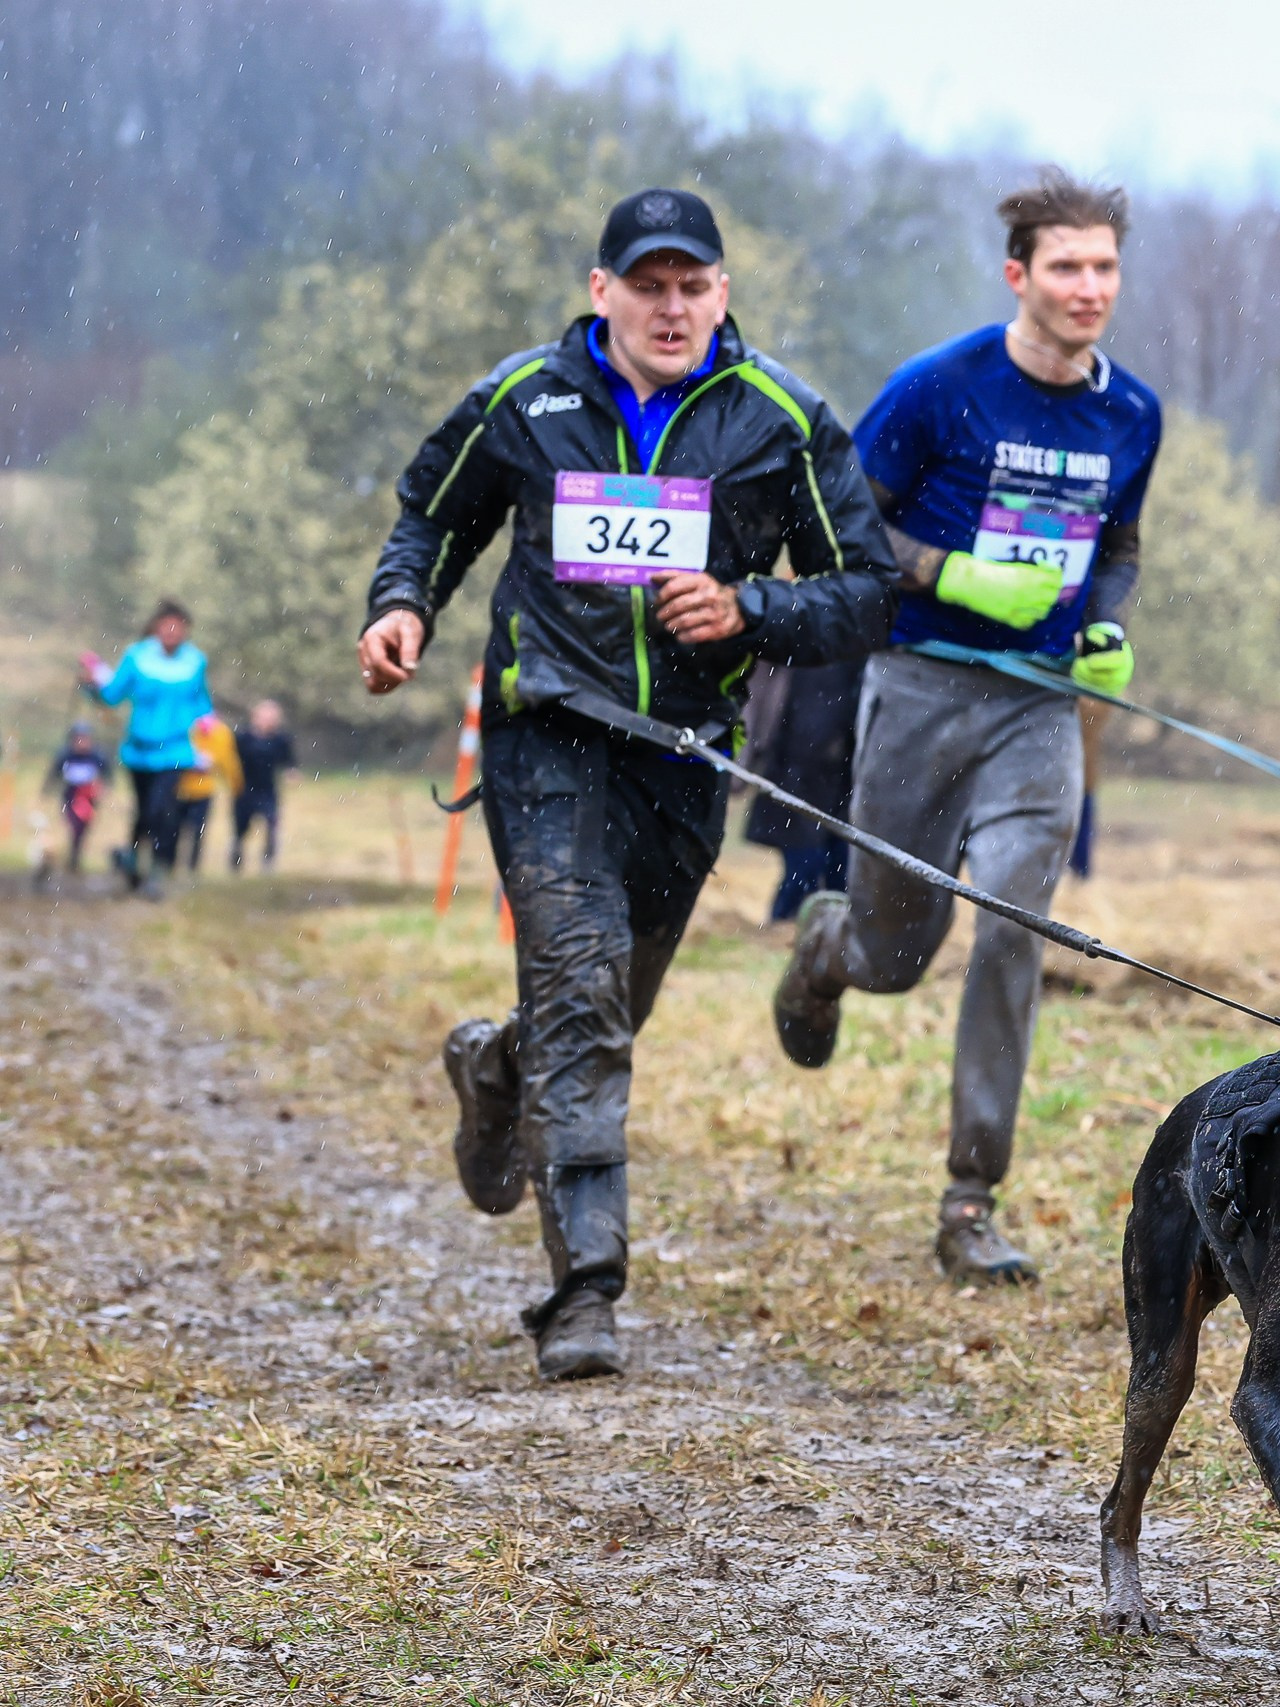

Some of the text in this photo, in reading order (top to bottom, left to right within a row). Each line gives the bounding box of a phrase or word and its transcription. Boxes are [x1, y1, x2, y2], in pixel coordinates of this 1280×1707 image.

[994, 441, 1045, 474] STATE
[1066, 451, 1110, 482] MIND
[587, 516, 671, 557] 342
